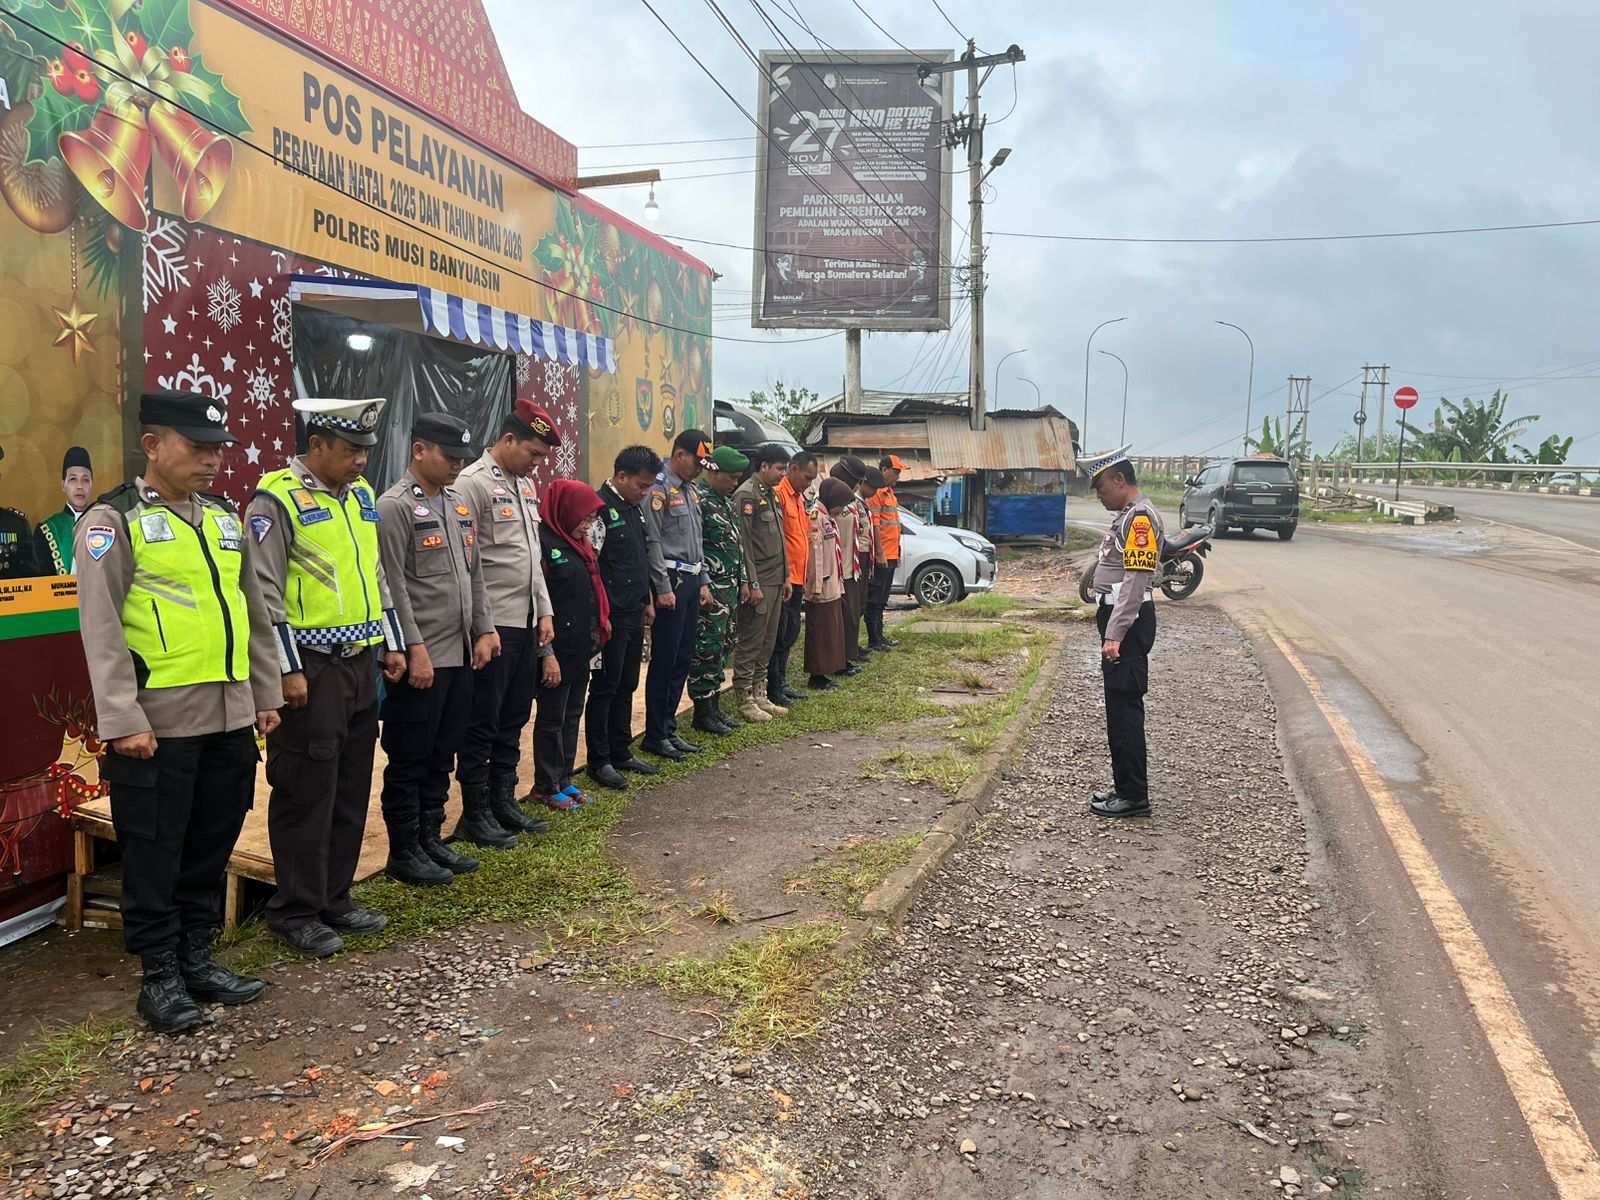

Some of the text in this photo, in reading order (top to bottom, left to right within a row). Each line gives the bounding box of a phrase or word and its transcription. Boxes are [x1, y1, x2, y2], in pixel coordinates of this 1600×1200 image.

[887, 107, 934, 121] DATANG
[303, 71, 504, 213] POS PELAYANAN
[788, 110, 846, 162] 27
[788, 163, 832, 176] 2024
[273, 126, 523, 263] PERAYAAN NATAL 2025 DAN TAHUN BARU 2026
[803, 192, 904, 205] PARTISIPASI DALAM
[779, 205, 927, 218] PEMILIHAN SERENTAK 2024
[798, 218, 910, 228] ADALAH WUJUD KEDAULATAN
[823, 228, 884, 237] WARGA NEGARA
[313, 208, 500, 293] POLRES MUSI BANYUASIN
[824, 259, 855, 268] Terima
[797, 269, 908, 283] Warga Sumatera Selatan!
